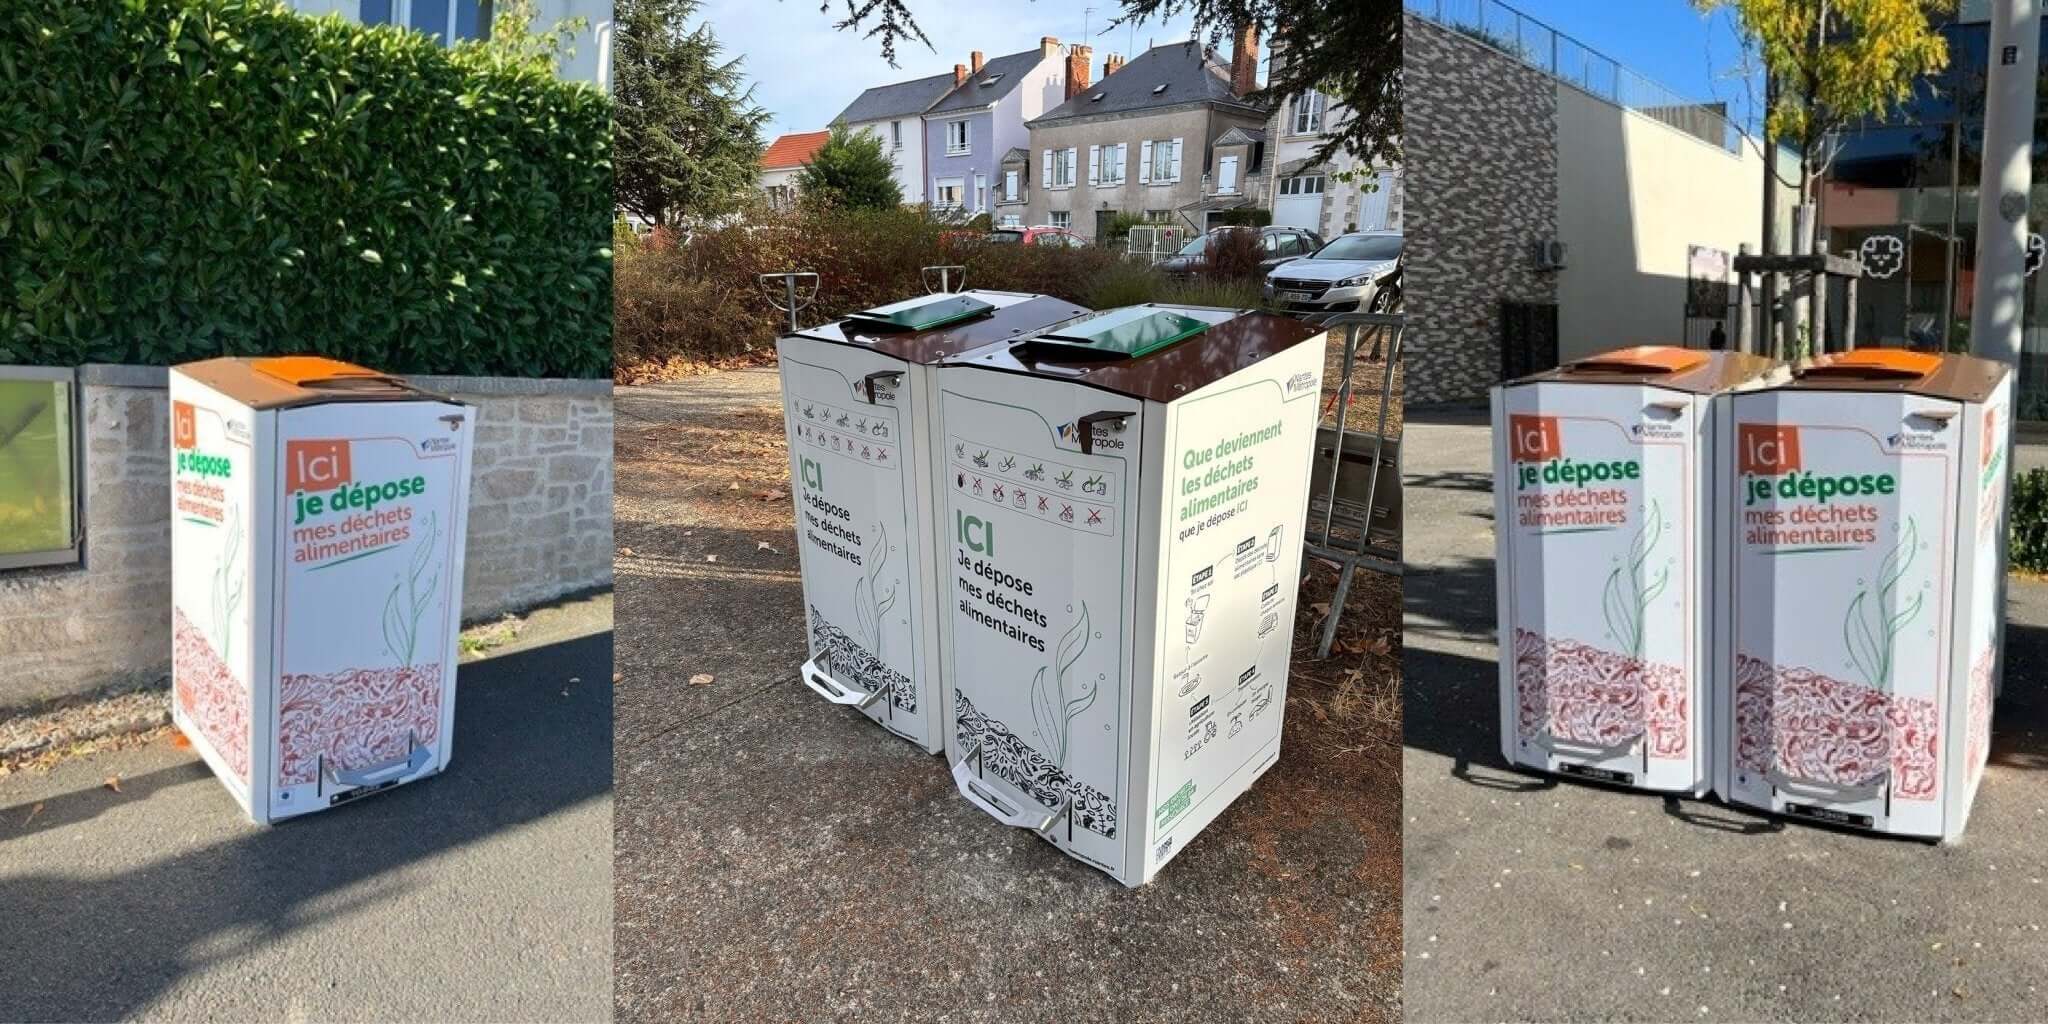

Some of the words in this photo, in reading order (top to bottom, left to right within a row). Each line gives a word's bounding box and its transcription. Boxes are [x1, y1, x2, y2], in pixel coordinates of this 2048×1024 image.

[176, 409, 191, 439] Ici
[1072, 422, 1109, 437] Ntes
[1516, 421, 1548, 454] Ici
[1183, 449, 1212, 470] Que
[1215, 420, 1282, 459] deviennent
[1747, 431, 1787, 466] Ici
[177, 450, 186, 475] je
[189, 448, 232, 480] dépose
[297, 446, 338, 483] Ici
[800, 454, 823, 492] ICI
[1181, 477, 1201, 496] les
[1204, 455, 1254, 488] déchets
[1517, 462, 1537, 490] je
[1543, 458, 1640, 488] dépose
[177, 479, 192, 495] mes
[193, 480, 224, 503] déchets
[294, 491, 325, 525] je
[330, 475, 425, 512] dépose
[803, 487, 811, 503] Je
[811, 494, 850, 522] dépose
[1180, 476, 1259, 521] alimentaires
[1518, 493, 1550, 508] mes
[1554, 488, 1627, 507] déchets
[1746, 473, 1772, 505] je
[1777, 471, 1895, 503] dépose
[177, 497, 224, 523] alimentaires
[293, 524, 336, 545] mes
[341, 505, 412, 534] déchets
[805, 510, 819, 528] mes
[821, 516, 862, 546] déchets
[1179, 525, 1195, 543] que
[1196, 520, 1205, 536] je
[1206, 507, 1235, 527] dépose
[1519, 508, 1627, 527] alimentaires
[1745, 510, 1784, 527] mes
[1789, 504, 1878, 524] déchets
[295, 525, 410, 563] alimentaires
[807, 529, 862, 566] alimentaires
[956, 509, 994, 557] ICI
[1746, 524, 1877, 545] alimentaires
[958, 549, 971, 570] Je
[974, 559, 1033, 596] dépose
[959, 575, 982, 600] mes
[986, 589, 1047, 628] déchets
[959, 599, 1045, 653] alimentaires
